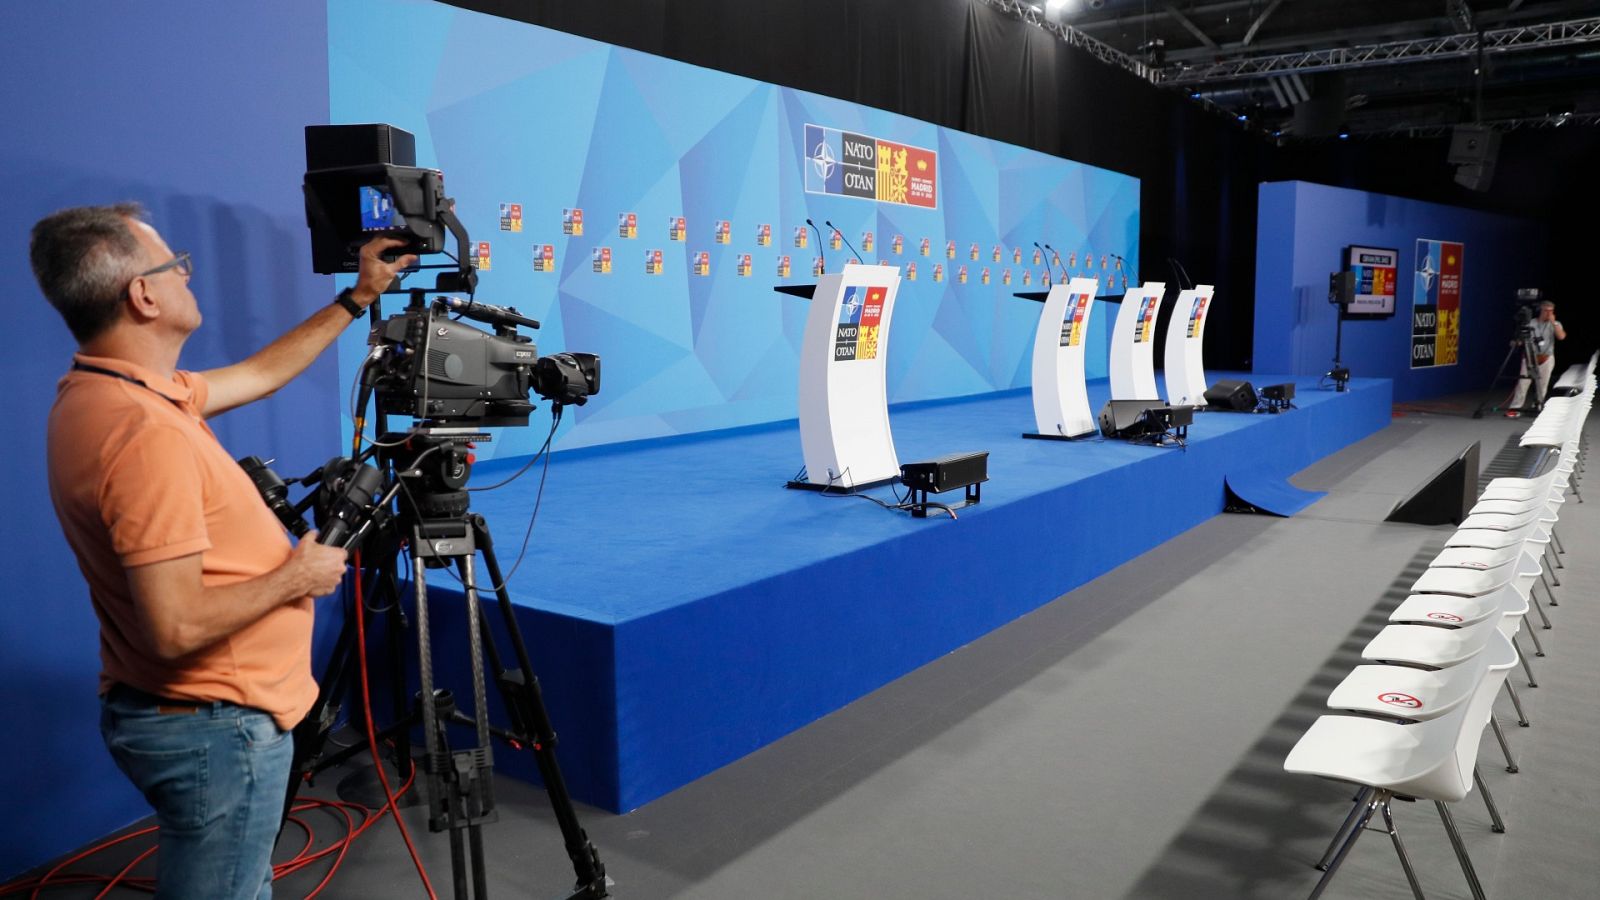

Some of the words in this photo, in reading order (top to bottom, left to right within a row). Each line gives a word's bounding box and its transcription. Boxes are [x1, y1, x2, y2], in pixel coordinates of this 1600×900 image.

[845, 141, 874, 160] NATO
[845, 173, 874, 191] OTAN
[911, 182, 933, 193] MADRID
[1414, 312, 1436, 327] NATO
[838, 327, 858, 338] NATO
[835, 346, 855, 357] OTAN
[1413, 344, 1435, 359] OTAN
